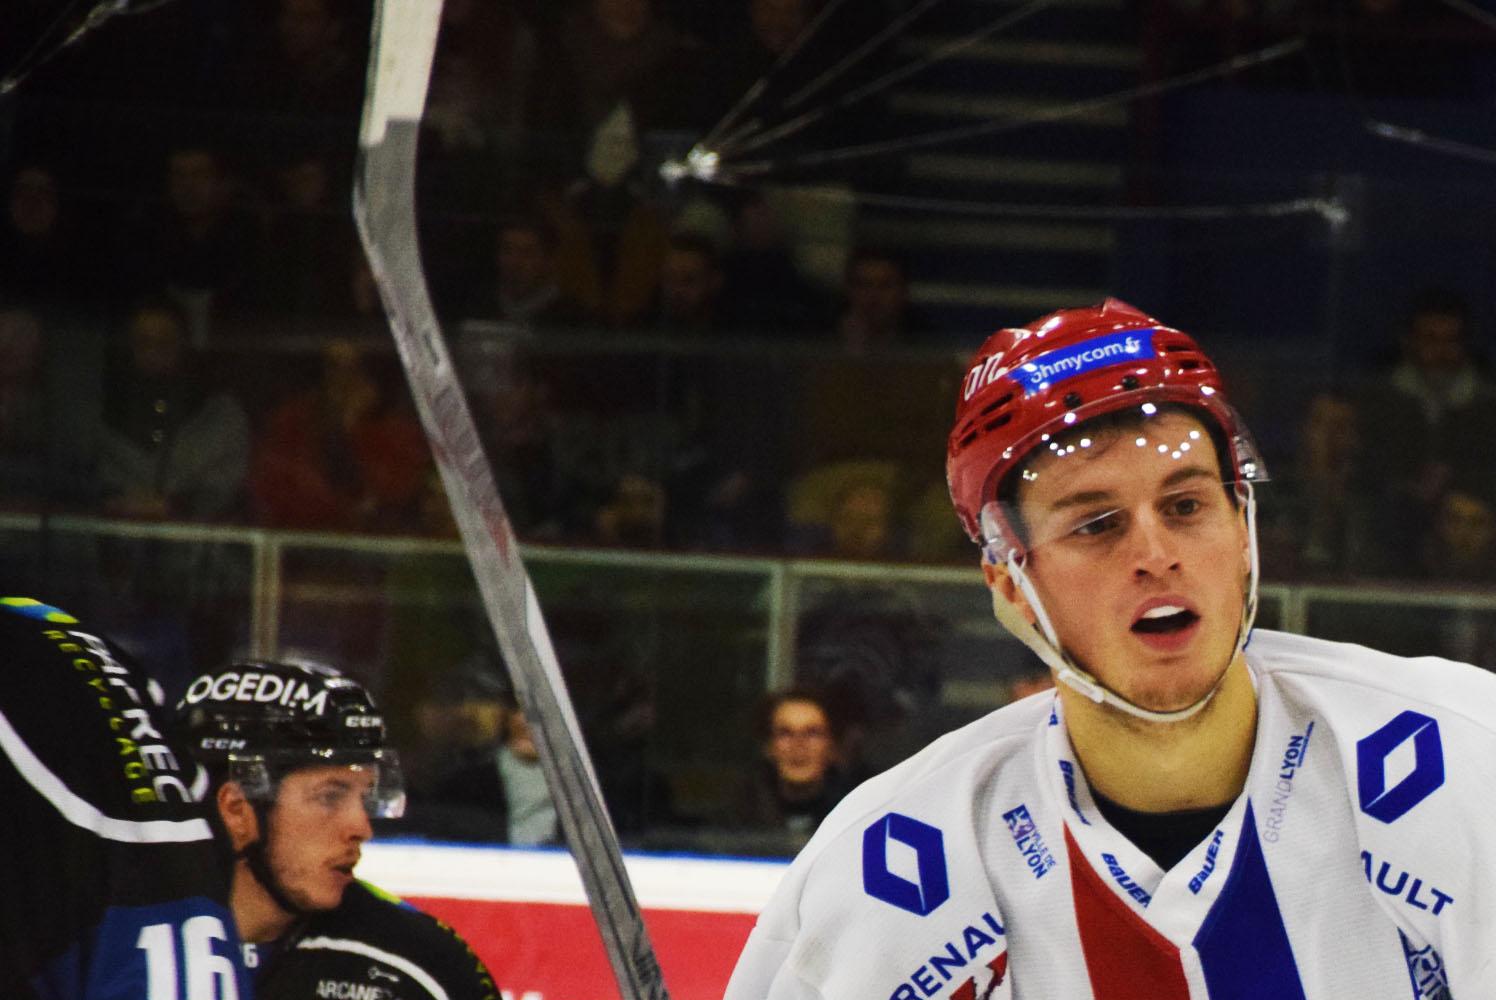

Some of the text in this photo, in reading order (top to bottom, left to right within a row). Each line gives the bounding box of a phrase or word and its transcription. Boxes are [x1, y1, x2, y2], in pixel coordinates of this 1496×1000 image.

[177, 672, 328, 716] OGEDIM
[201, 737, 247, 751] CCM
[1016, 836, 1048, 880] LYON
